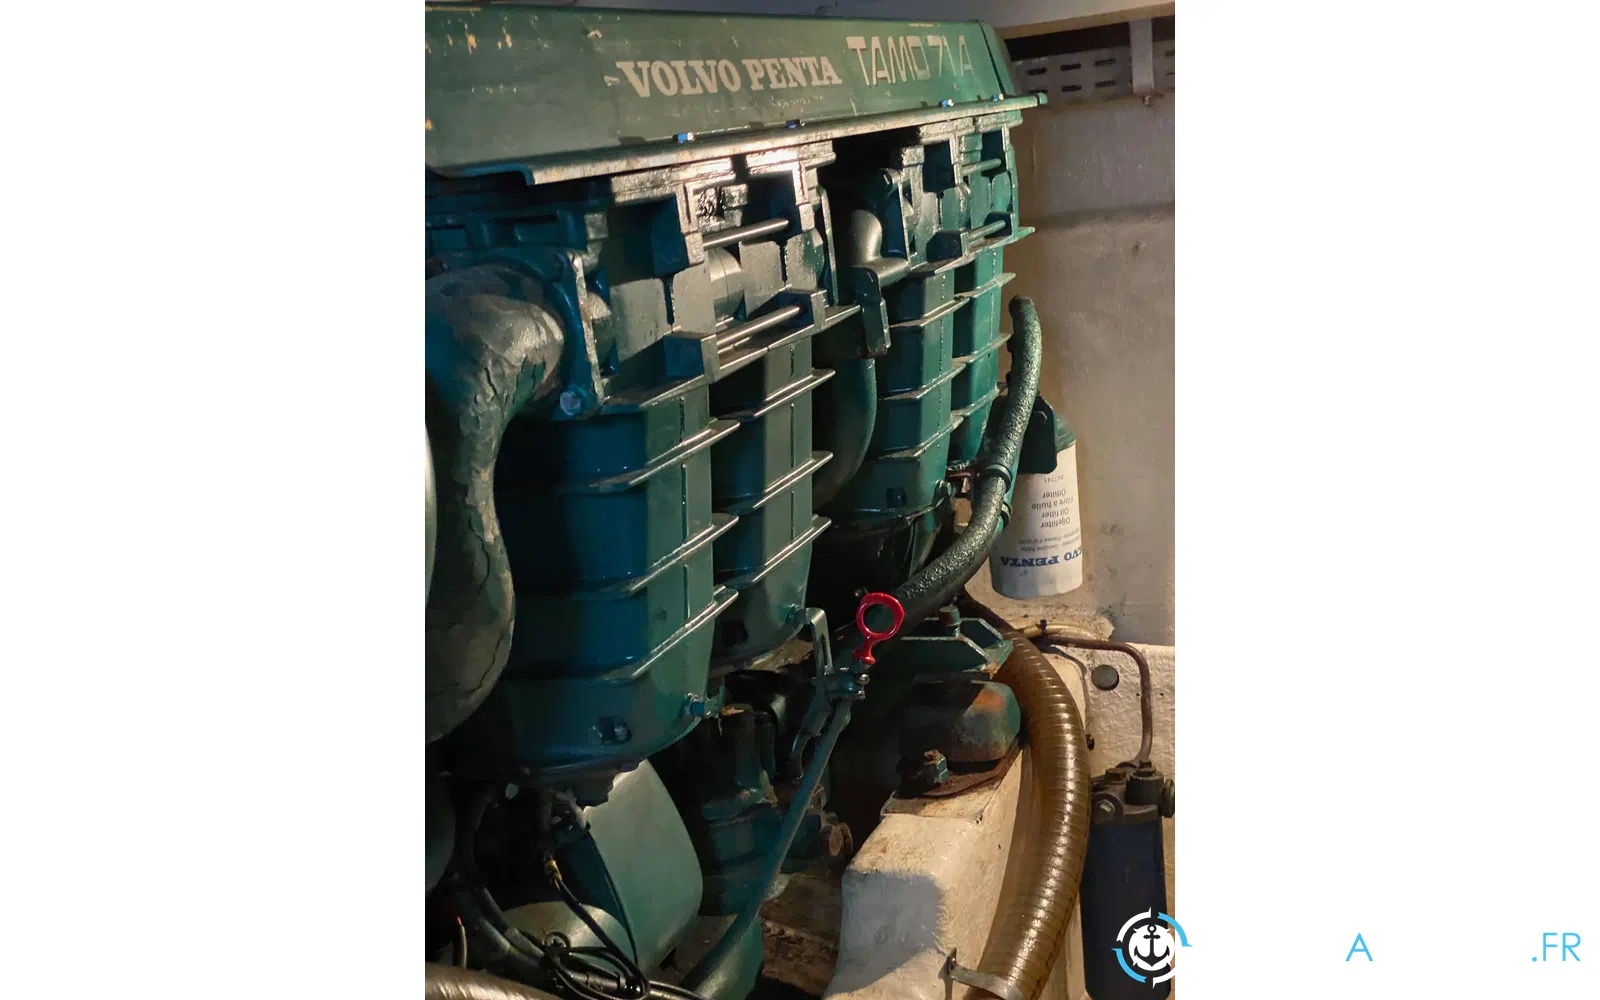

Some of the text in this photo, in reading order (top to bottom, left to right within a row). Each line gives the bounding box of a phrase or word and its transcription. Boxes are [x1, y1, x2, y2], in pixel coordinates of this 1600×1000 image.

[615, 56, 843, 98] VOLVO PENTA
[1031, 501, 1052, 511] huile
[1041, 510, 1060, 518] filter
[999, 555, 1059, 567] PENTA
